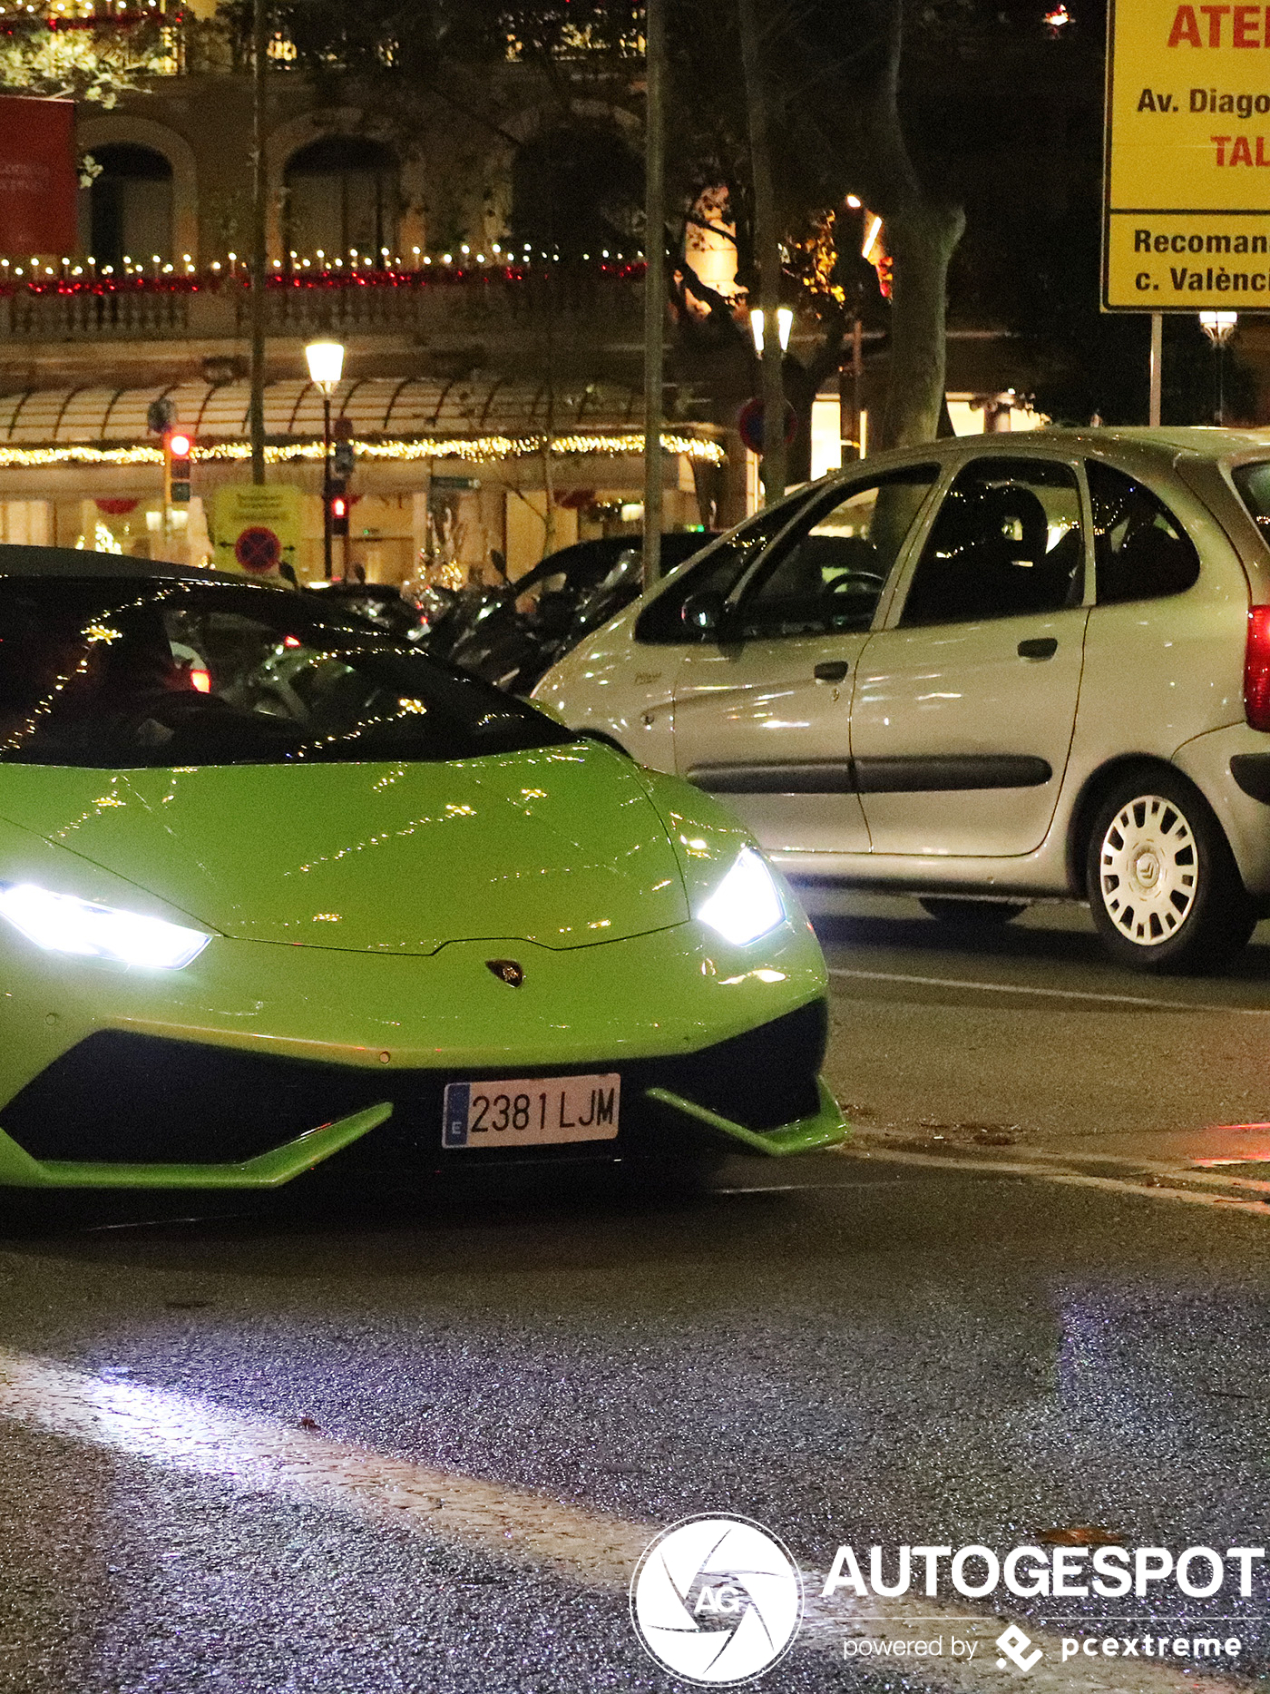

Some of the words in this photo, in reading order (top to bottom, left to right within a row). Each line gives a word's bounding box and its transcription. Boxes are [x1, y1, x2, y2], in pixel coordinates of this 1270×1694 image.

[1167, 5, 1270, 48] ATE
[1137, 89, 1179, 112] Av.
[1134, 230, 1270, 253] Recoman
[1135, 271, 1159, 290] c.
[1170, 268, 1270, 290] Valènc
[471, 1093, 546, 1132] 2381
[558, 1088, 615, 1128] LJM
